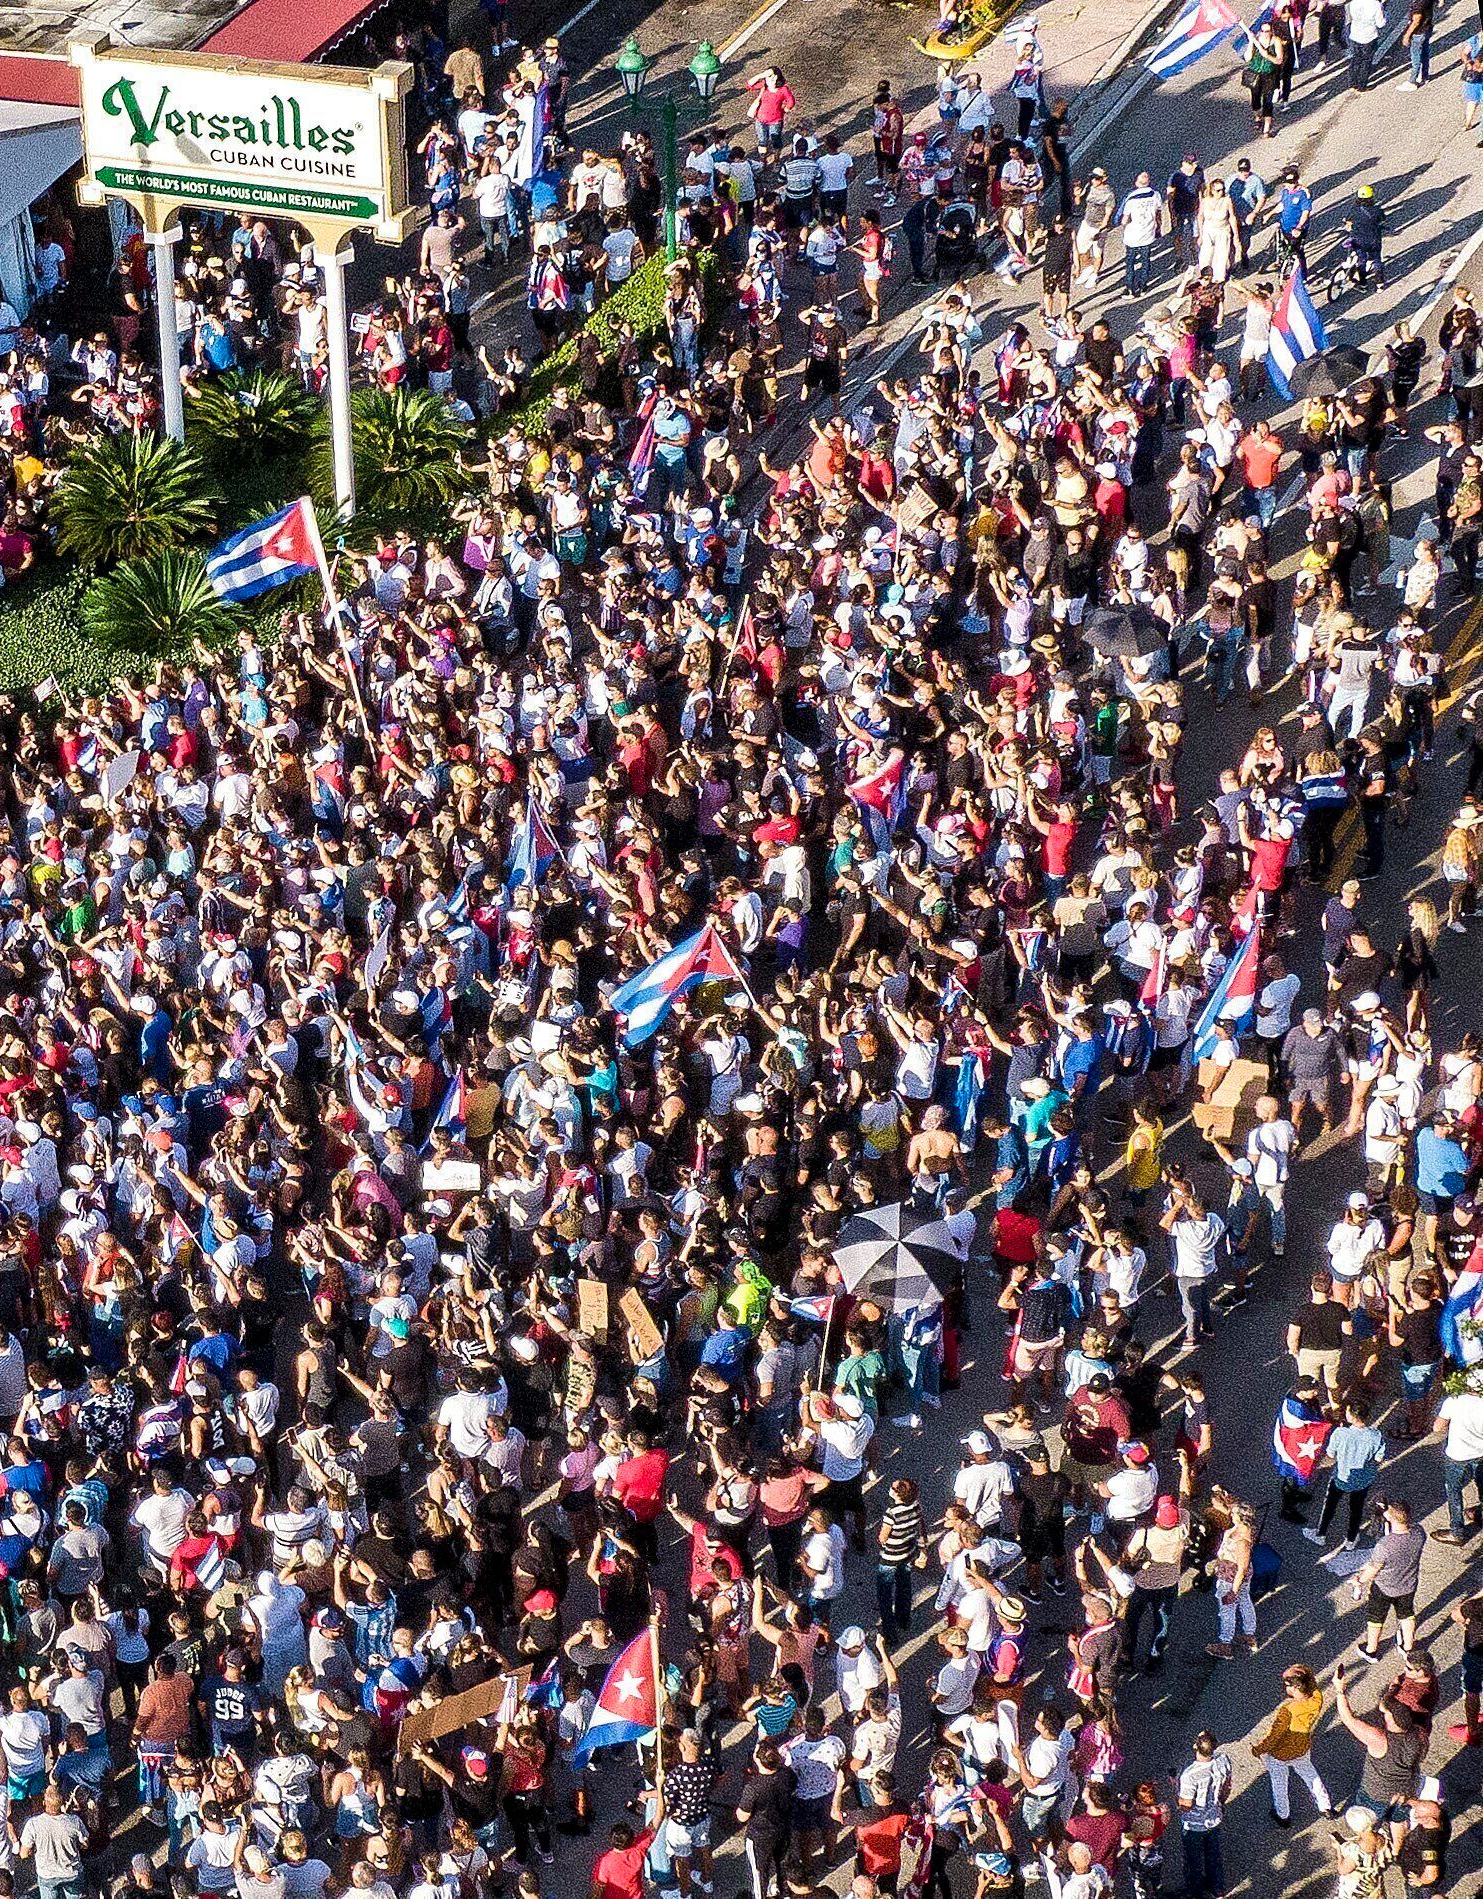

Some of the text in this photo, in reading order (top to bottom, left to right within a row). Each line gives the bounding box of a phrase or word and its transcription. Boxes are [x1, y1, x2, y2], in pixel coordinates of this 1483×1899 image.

[101, 76, 356, 156] Versailles
[210, 149, 356, 178] CUBAN CUISINE
[115, 172, 135, 185] THE
[136, 174, 180, 192] WORLD'S
[180, 180, 208, 195] MOST
[209, 183, 251, 201] FAMOUS
[252, 189, 287, 204] CUBAN
[215, 1698, 245, 1720] 99
